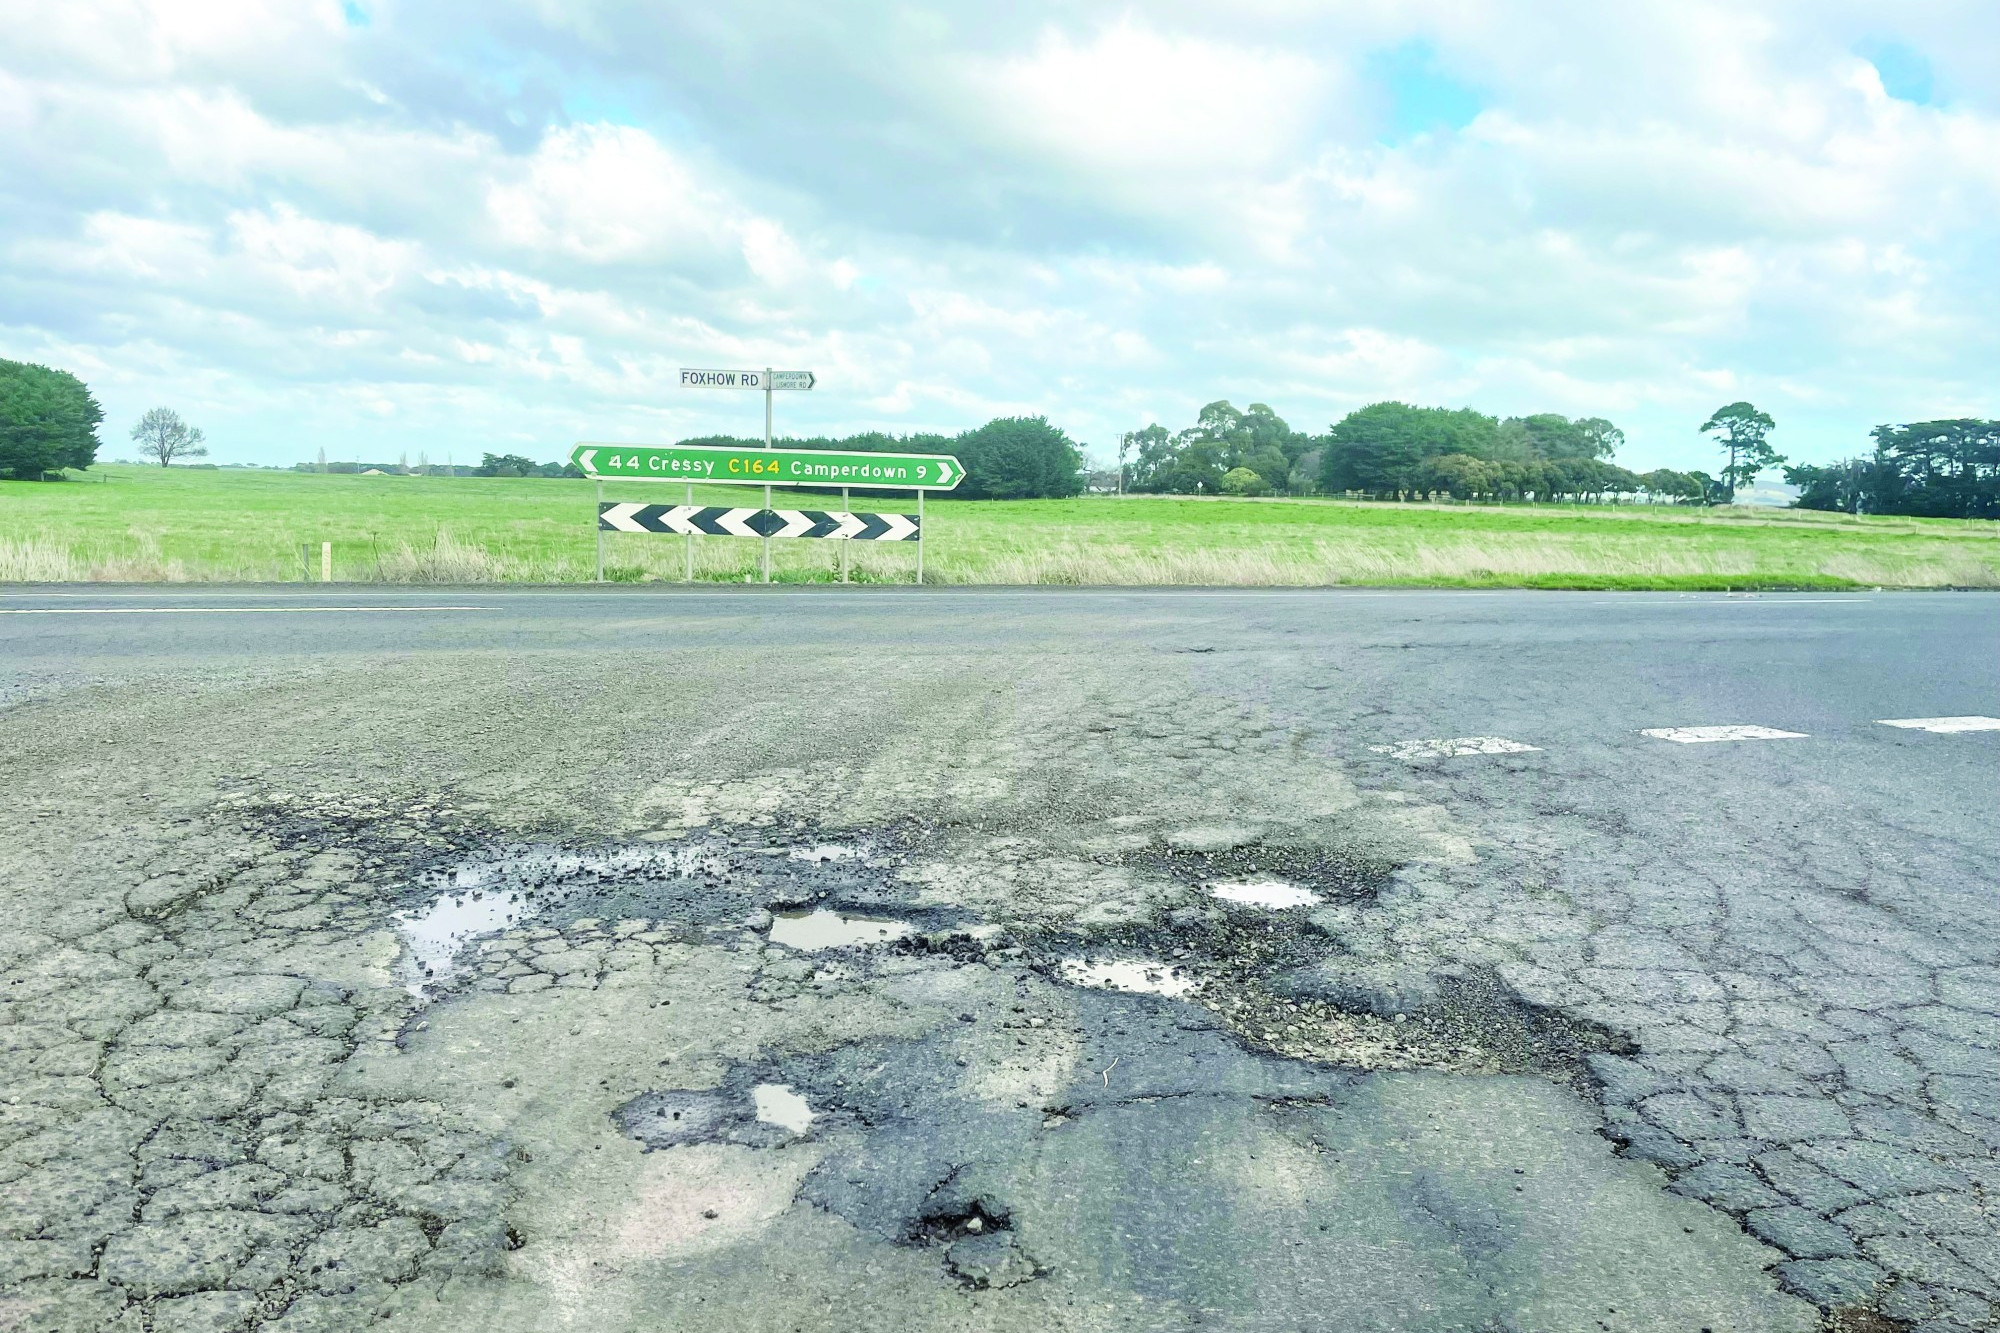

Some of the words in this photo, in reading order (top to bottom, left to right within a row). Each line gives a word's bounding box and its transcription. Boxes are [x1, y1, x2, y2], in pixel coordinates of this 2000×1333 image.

[682, 372, 735, 386] FOXHOW
[741, 374, 759, 387] RD
[608, 455, 640, 470] 44
[649, 456, 714, 476] Cressy
[728, 458, 780, 474] C164
[790, 460, 907, 480] Camperdown
[916, 465, 927, 479] 9
